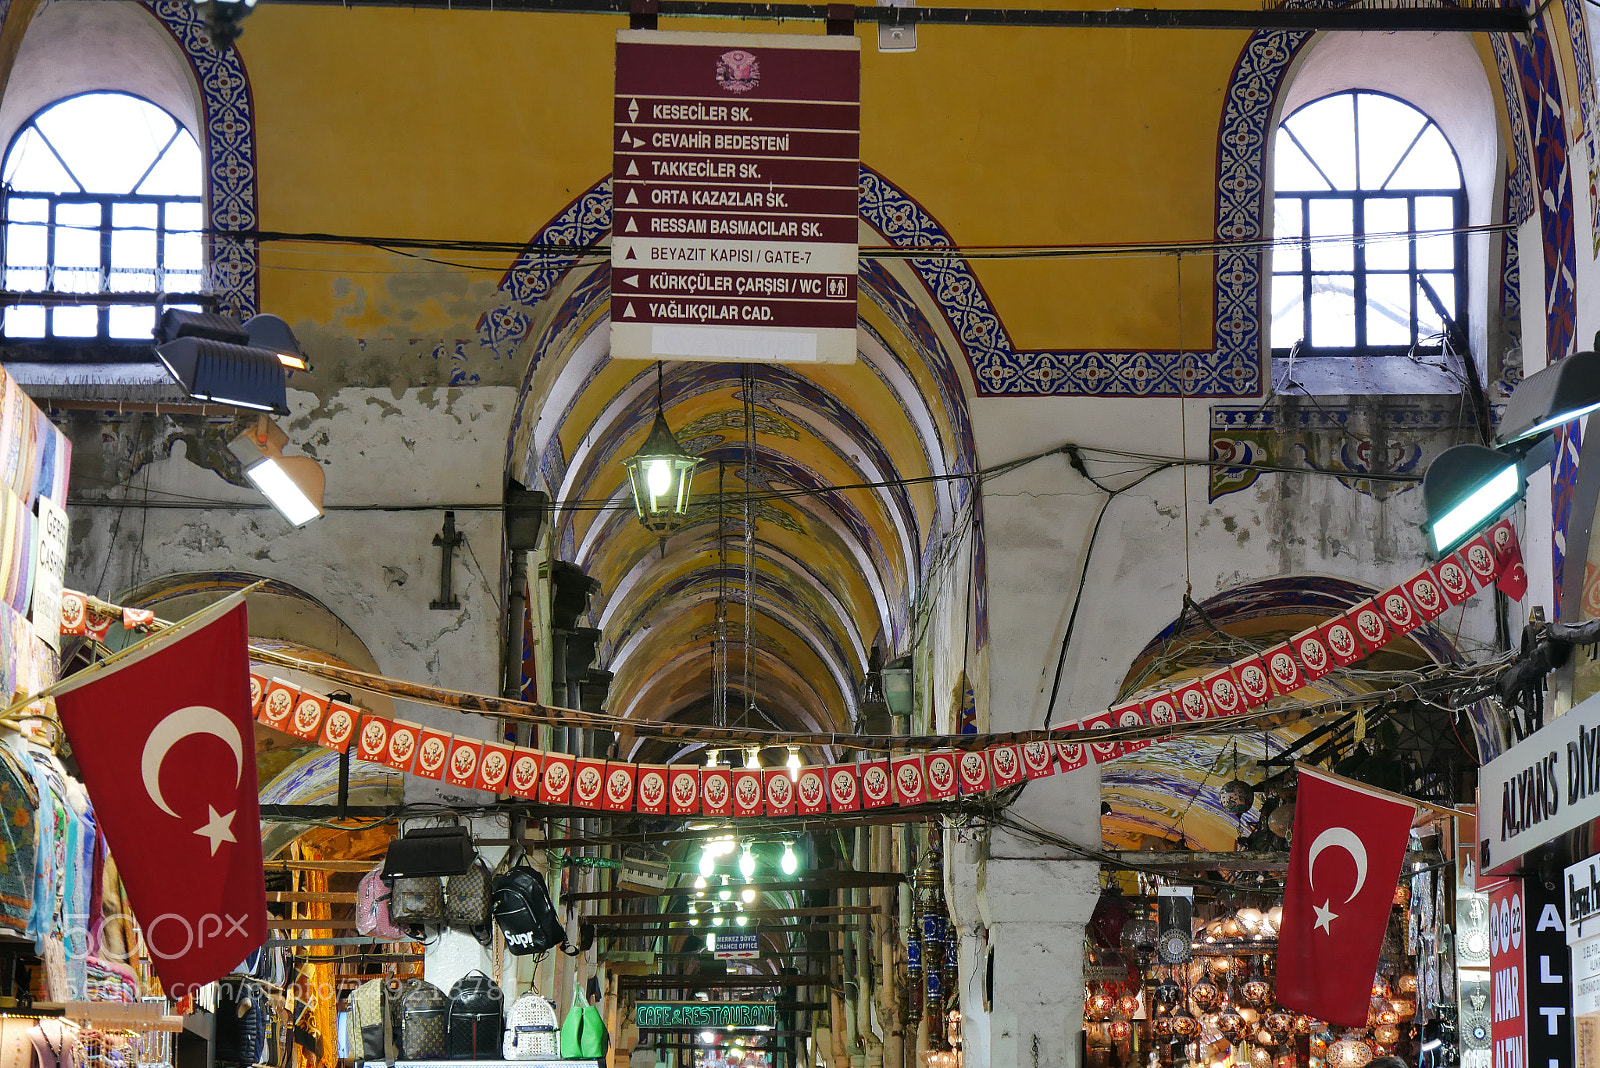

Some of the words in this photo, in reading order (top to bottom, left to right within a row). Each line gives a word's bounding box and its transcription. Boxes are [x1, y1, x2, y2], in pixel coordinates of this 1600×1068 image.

[653, 102, 727, 121] KESECİLER
[730, 107, 753, 122] SK.
[652, 131, 712, 149] CEVAHİR
[714, 133, 790, 151] BEDESTENİ
[652, 160, 736, 177] TAKKECİLER
[739, 164, 762, 178] SK.
[651, 190, 689, 204] ORTA
[692, 190, 763, 207] KAZAZLAR
[766, 192, 788, 208] SK.
[651, 218, 707, 234] RESSAM
[710, 220, 798, 236] BASMACILAR
[801, 222, 823, 237] SK.
[651, 247, 707, 262] BEYAZIT
[710, 248, 753, 262] KAPISI
[756, 250, 761, 263] /
[764, 250, 812, 264] GATE-7
[650, 272, 732, 294] KÜRKÇÜLER
[736, 277, 789, 295] ÇARŞISI
[792, 279, 796, 294] /
[800, 279, 822, 294] WC
[649, 300, 740, 322] YAĞLIKÇILAR
[742, 306, 774, 321] CAD.
[1486, 573, 1499, 583] ATA
[1458, 591, 1470, 601] ATA
[1431, 608, 1444, 617] ATA
[1402, 623, 1416, 632] ATA
[1374, 639, 1387, 649] ATA
[1344, 655, 1358, 663] ATA
[1316, 668, 1329, 677] ATA
[1286, 683, 1299, 692] ATA
[1255, 696, 1269, 704] ATA
[264, 719, 279, 728] ATA
[293, 730, 308, 739] ATA
[325, 741, 339, 750] ATA
[1101, 752, 1116, 760] ATA
[389, 761, 404, 769] ATA
[1068, 762, 1082, 770] ATA
[420, 770, 435, 778] ATA
[1501, 751, 1559, 842] ALYANS
[1490, 917, 1498, 942] 14
[1501, 912, 1509, 938] 18
[1512, 906, 1520, 934] 22
[1494, 966, 1520, 1023] AYAR
